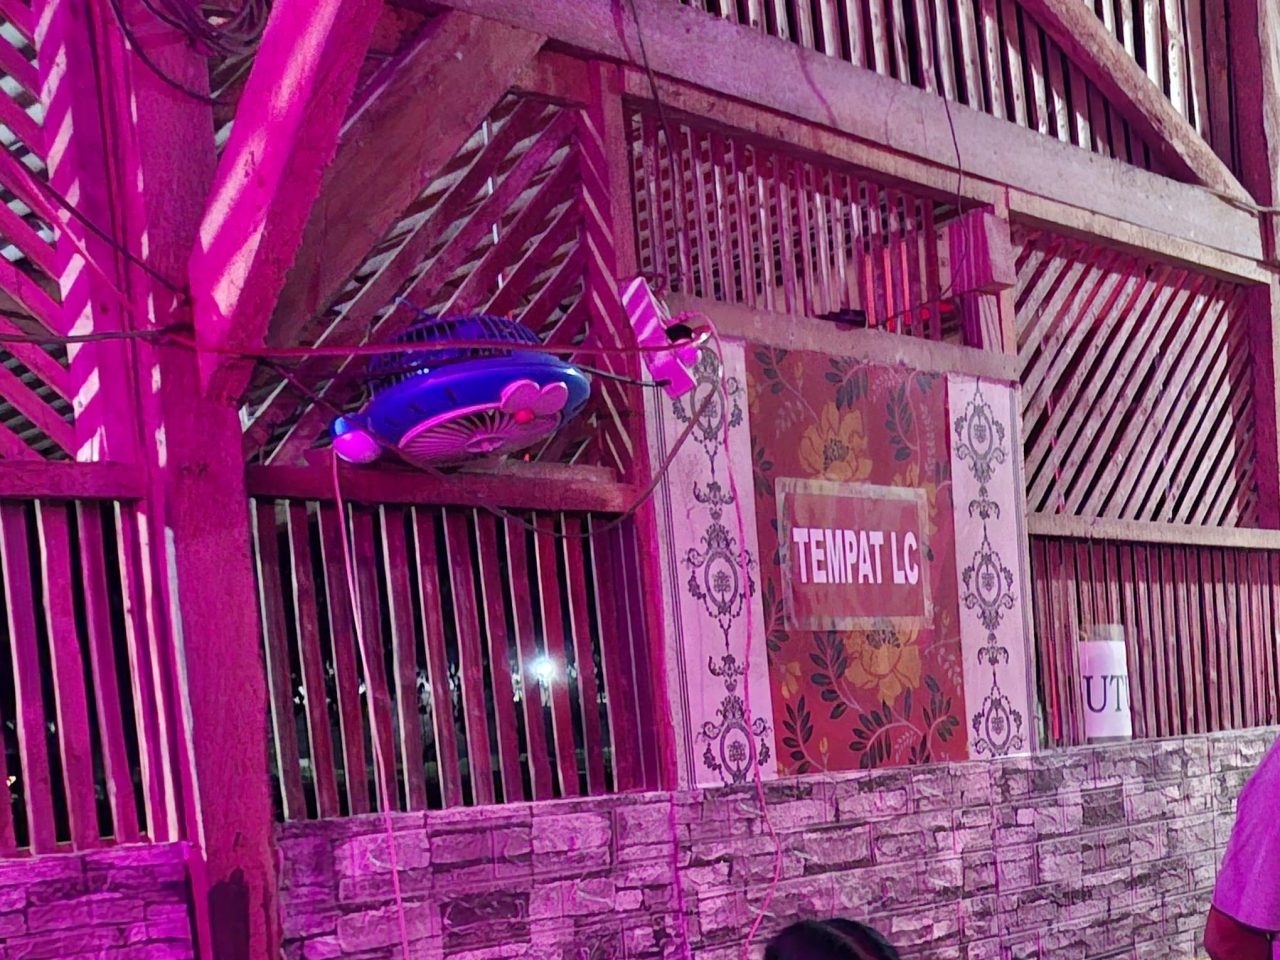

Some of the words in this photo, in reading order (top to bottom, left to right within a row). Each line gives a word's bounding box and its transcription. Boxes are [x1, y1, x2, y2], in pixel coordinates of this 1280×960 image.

[792, 526, 884, 585] TEMPAT
[891, 530, 920, 585] LC
[1082, 674, 1131, 713] UT
